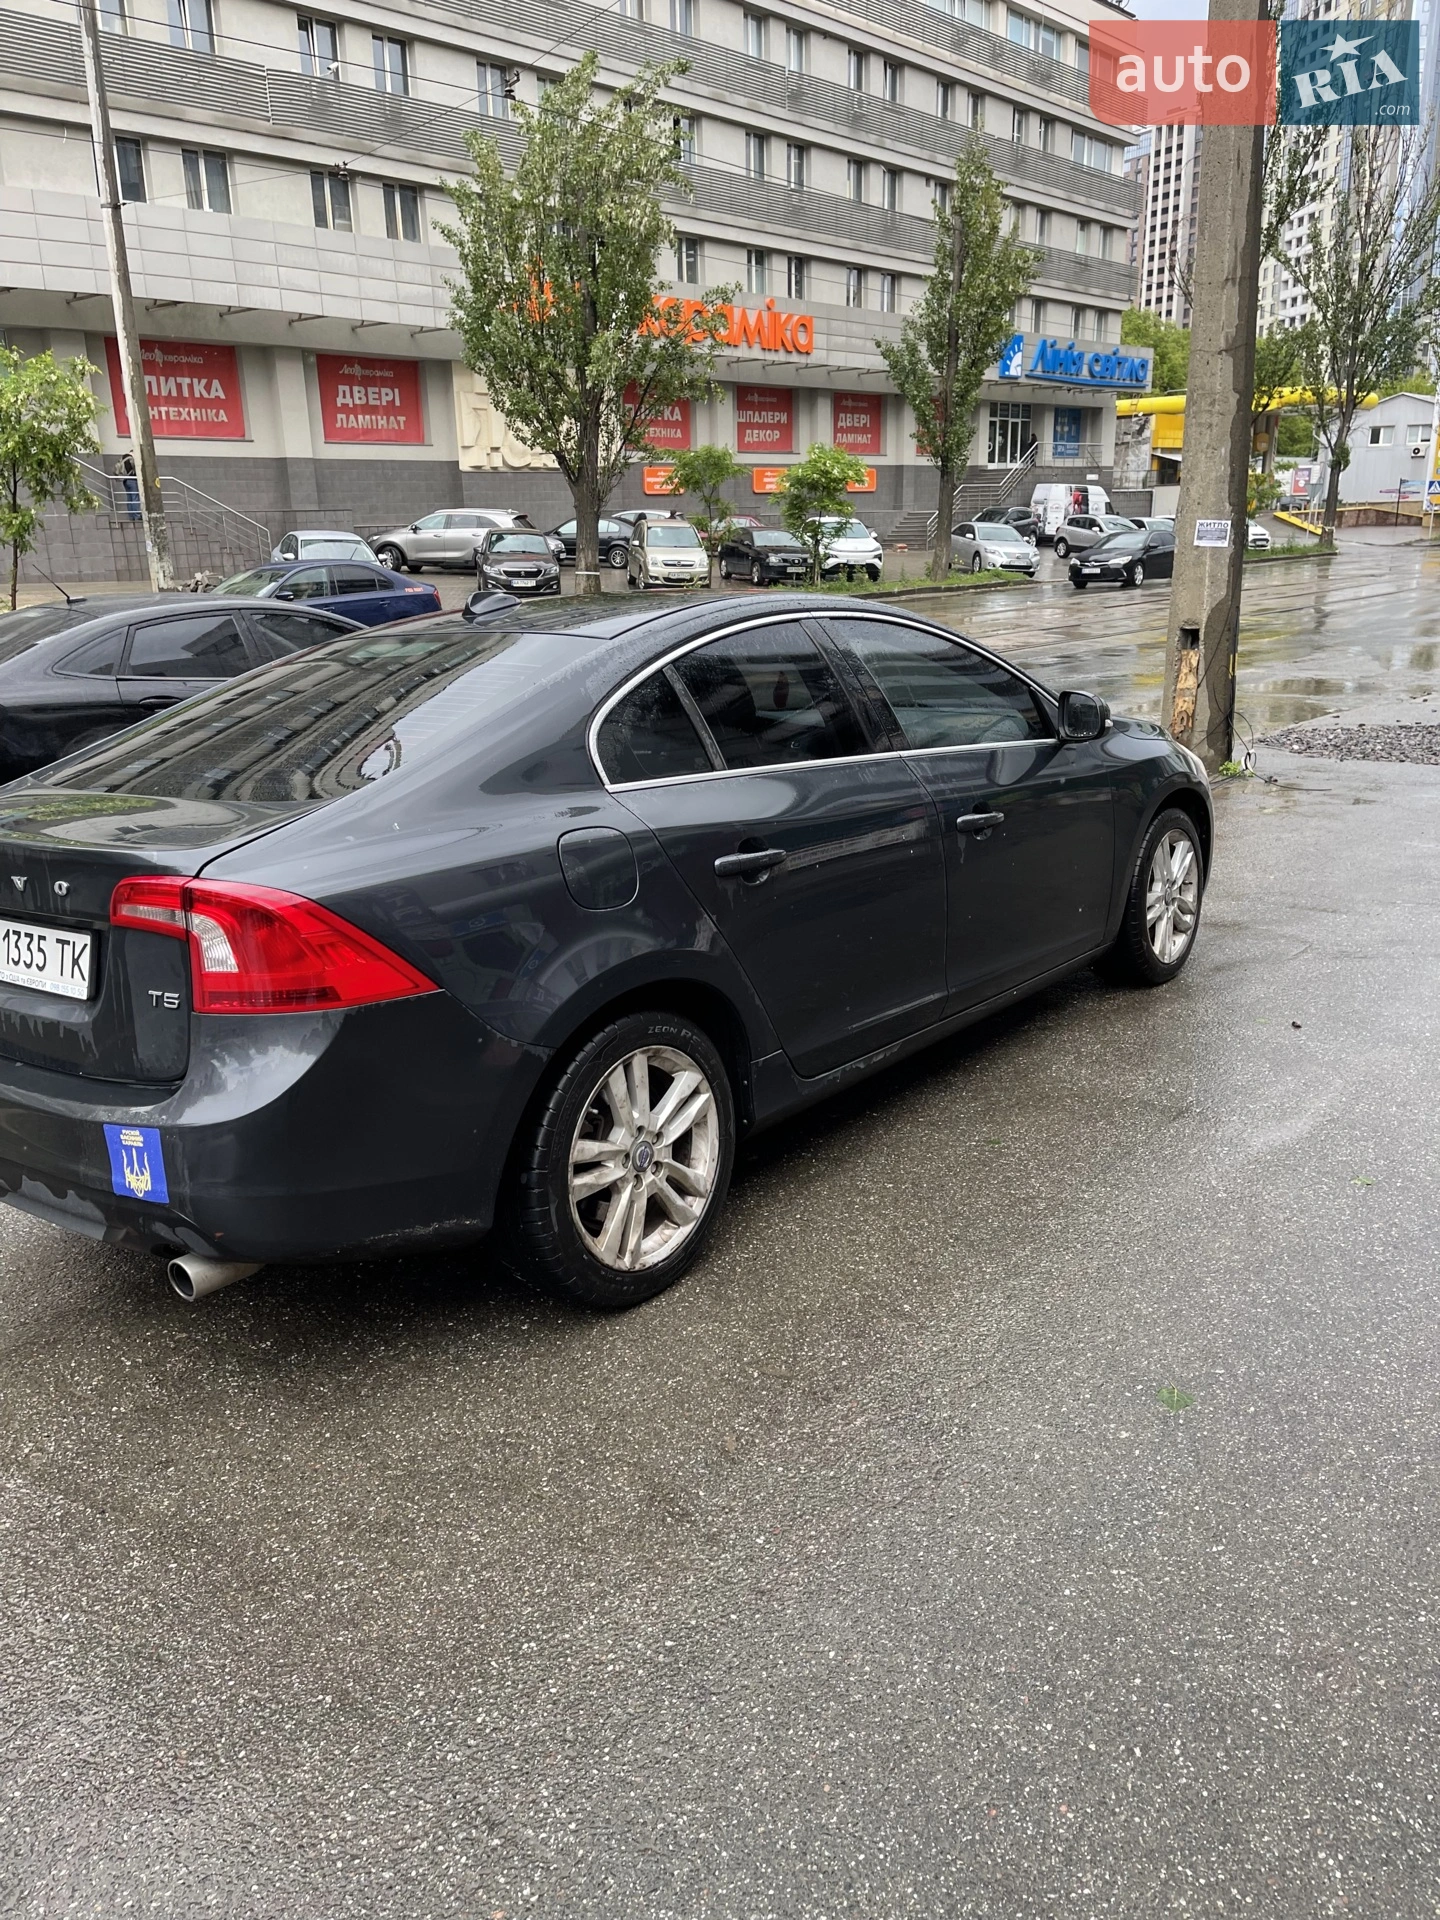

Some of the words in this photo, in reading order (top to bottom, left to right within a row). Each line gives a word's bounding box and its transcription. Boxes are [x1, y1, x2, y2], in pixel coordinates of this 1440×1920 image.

[1030, 338, 1085, 377] Лінія
[121, 374, 226, 400] ЛИТКА
[336, 384, 401, 408] ДВЕРІ
[125, 406, 229, 423] НТЕХНІКА
[335, 413, 406, 430] ЛАМІНАТ
[737, 410, 788, 424] ШПАЛЕРИ
[837, 413, 870, 428] ДВЕРІ
[744, 429, 780, 443] ДЕКОР
[835, 433, 872, 444] ЛАМІНАТ
[2, 928, 47, 972] 1335
[56, 938, 88, 982] TK
[148, 990, 181, 1009] T5
[648, 1025, 678, 1034] ZEON
